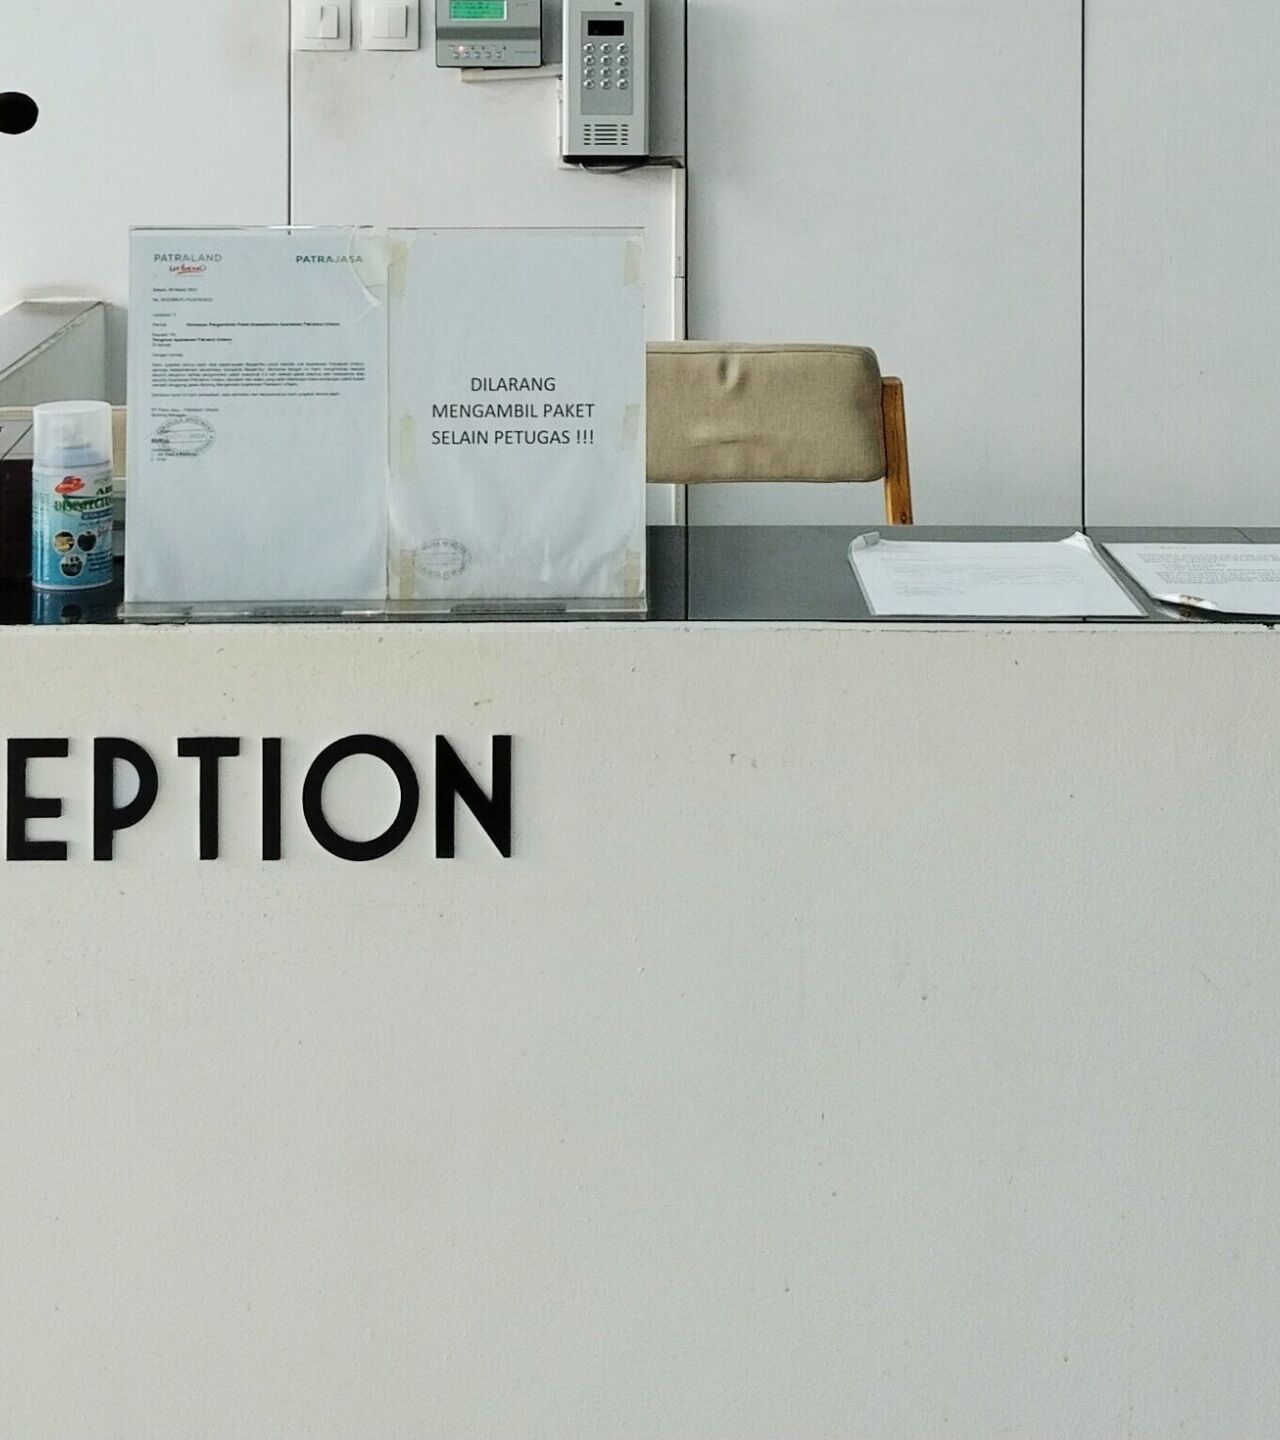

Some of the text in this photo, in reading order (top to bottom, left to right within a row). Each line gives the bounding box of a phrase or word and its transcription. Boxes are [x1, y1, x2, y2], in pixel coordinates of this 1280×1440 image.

[153, 253, 223, 263] PATRALAND
[295, 254, 364, 264] PATRAJASA
[470, 376, 556, 392] DILARANG
[431, 402, 596, 419] MENGAMBIL PAKET
[431, 429, 594, 446] SELAIN PETUGAS !!!
